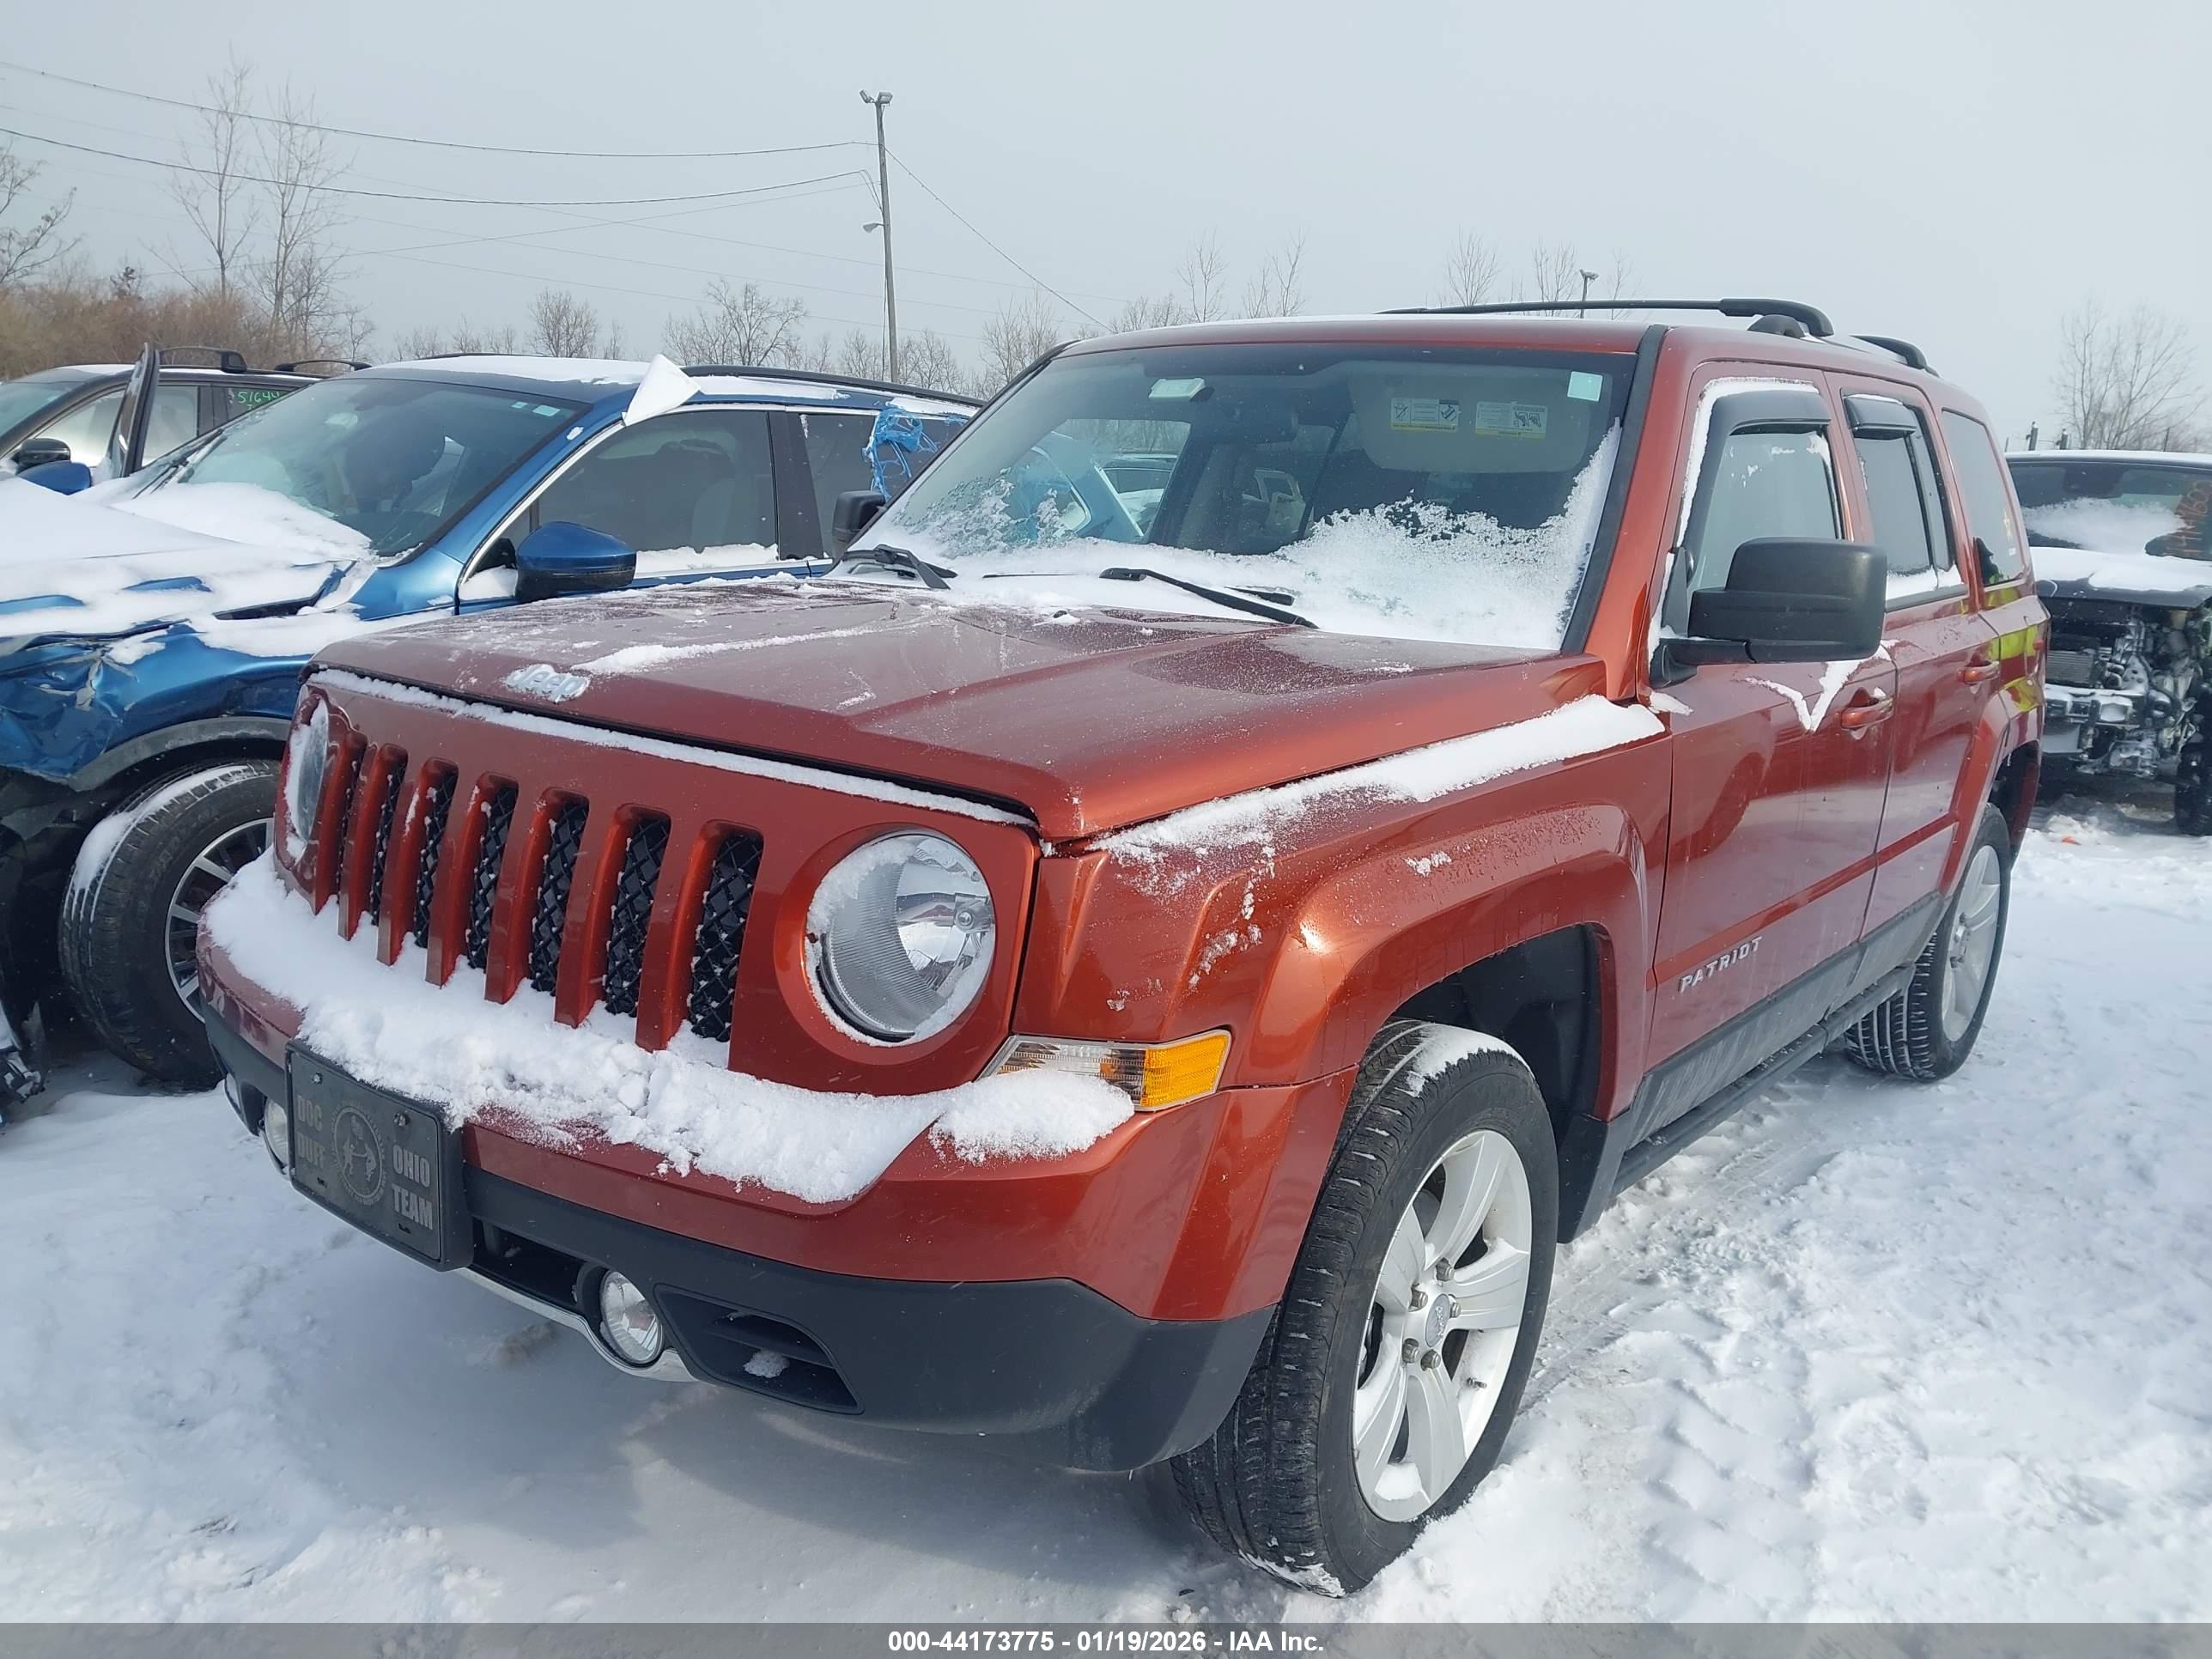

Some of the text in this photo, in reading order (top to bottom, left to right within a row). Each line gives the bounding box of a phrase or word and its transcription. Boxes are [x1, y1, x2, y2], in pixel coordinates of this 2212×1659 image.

[509, 664, 588, 704] Jeep
[1678, 936, 1763, 994] PATRIOT
[298, 1095, 323, 1131] DOC
[392, 1146, 430, 1188] OHIO
[392, 1184, 433, 1230] TEAM
